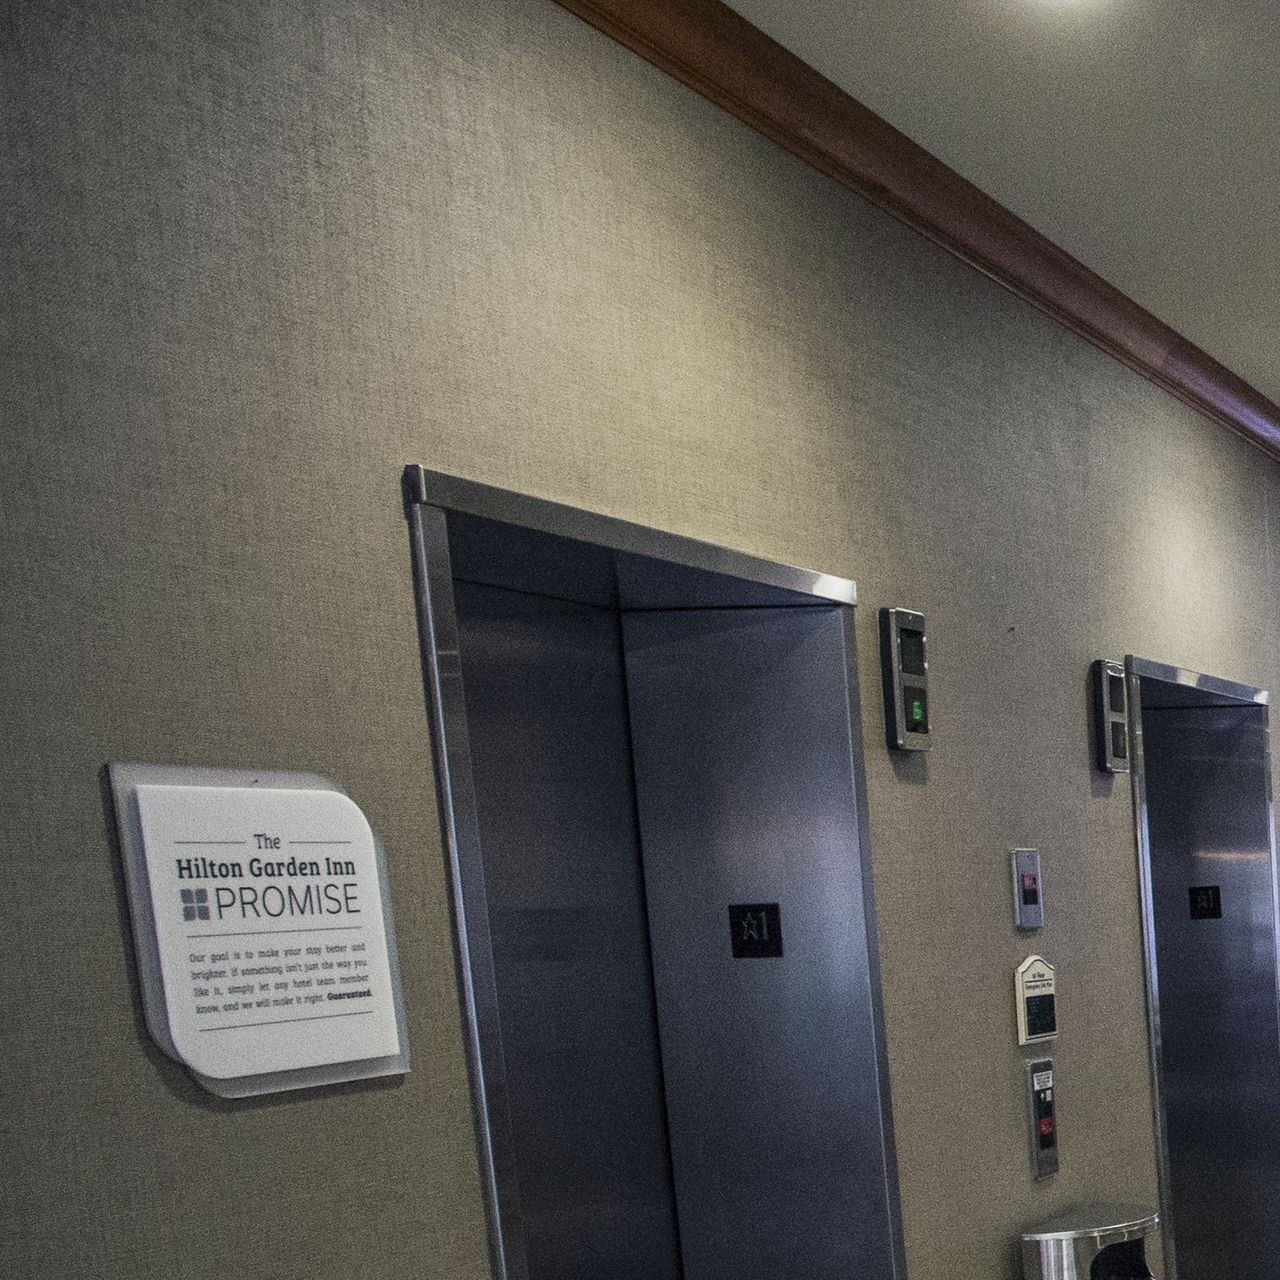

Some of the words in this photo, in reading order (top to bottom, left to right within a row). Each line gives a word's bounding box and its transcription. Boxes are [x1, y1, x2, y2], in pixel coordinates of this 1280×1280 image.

[253, 833, 281, 850] The
[176, 857, 244, 879] Hilton
[249, 857, 321, 877] Garden
[325, 857, 356, 876] Inn
[215, 884, 361, 919] PROMISE
